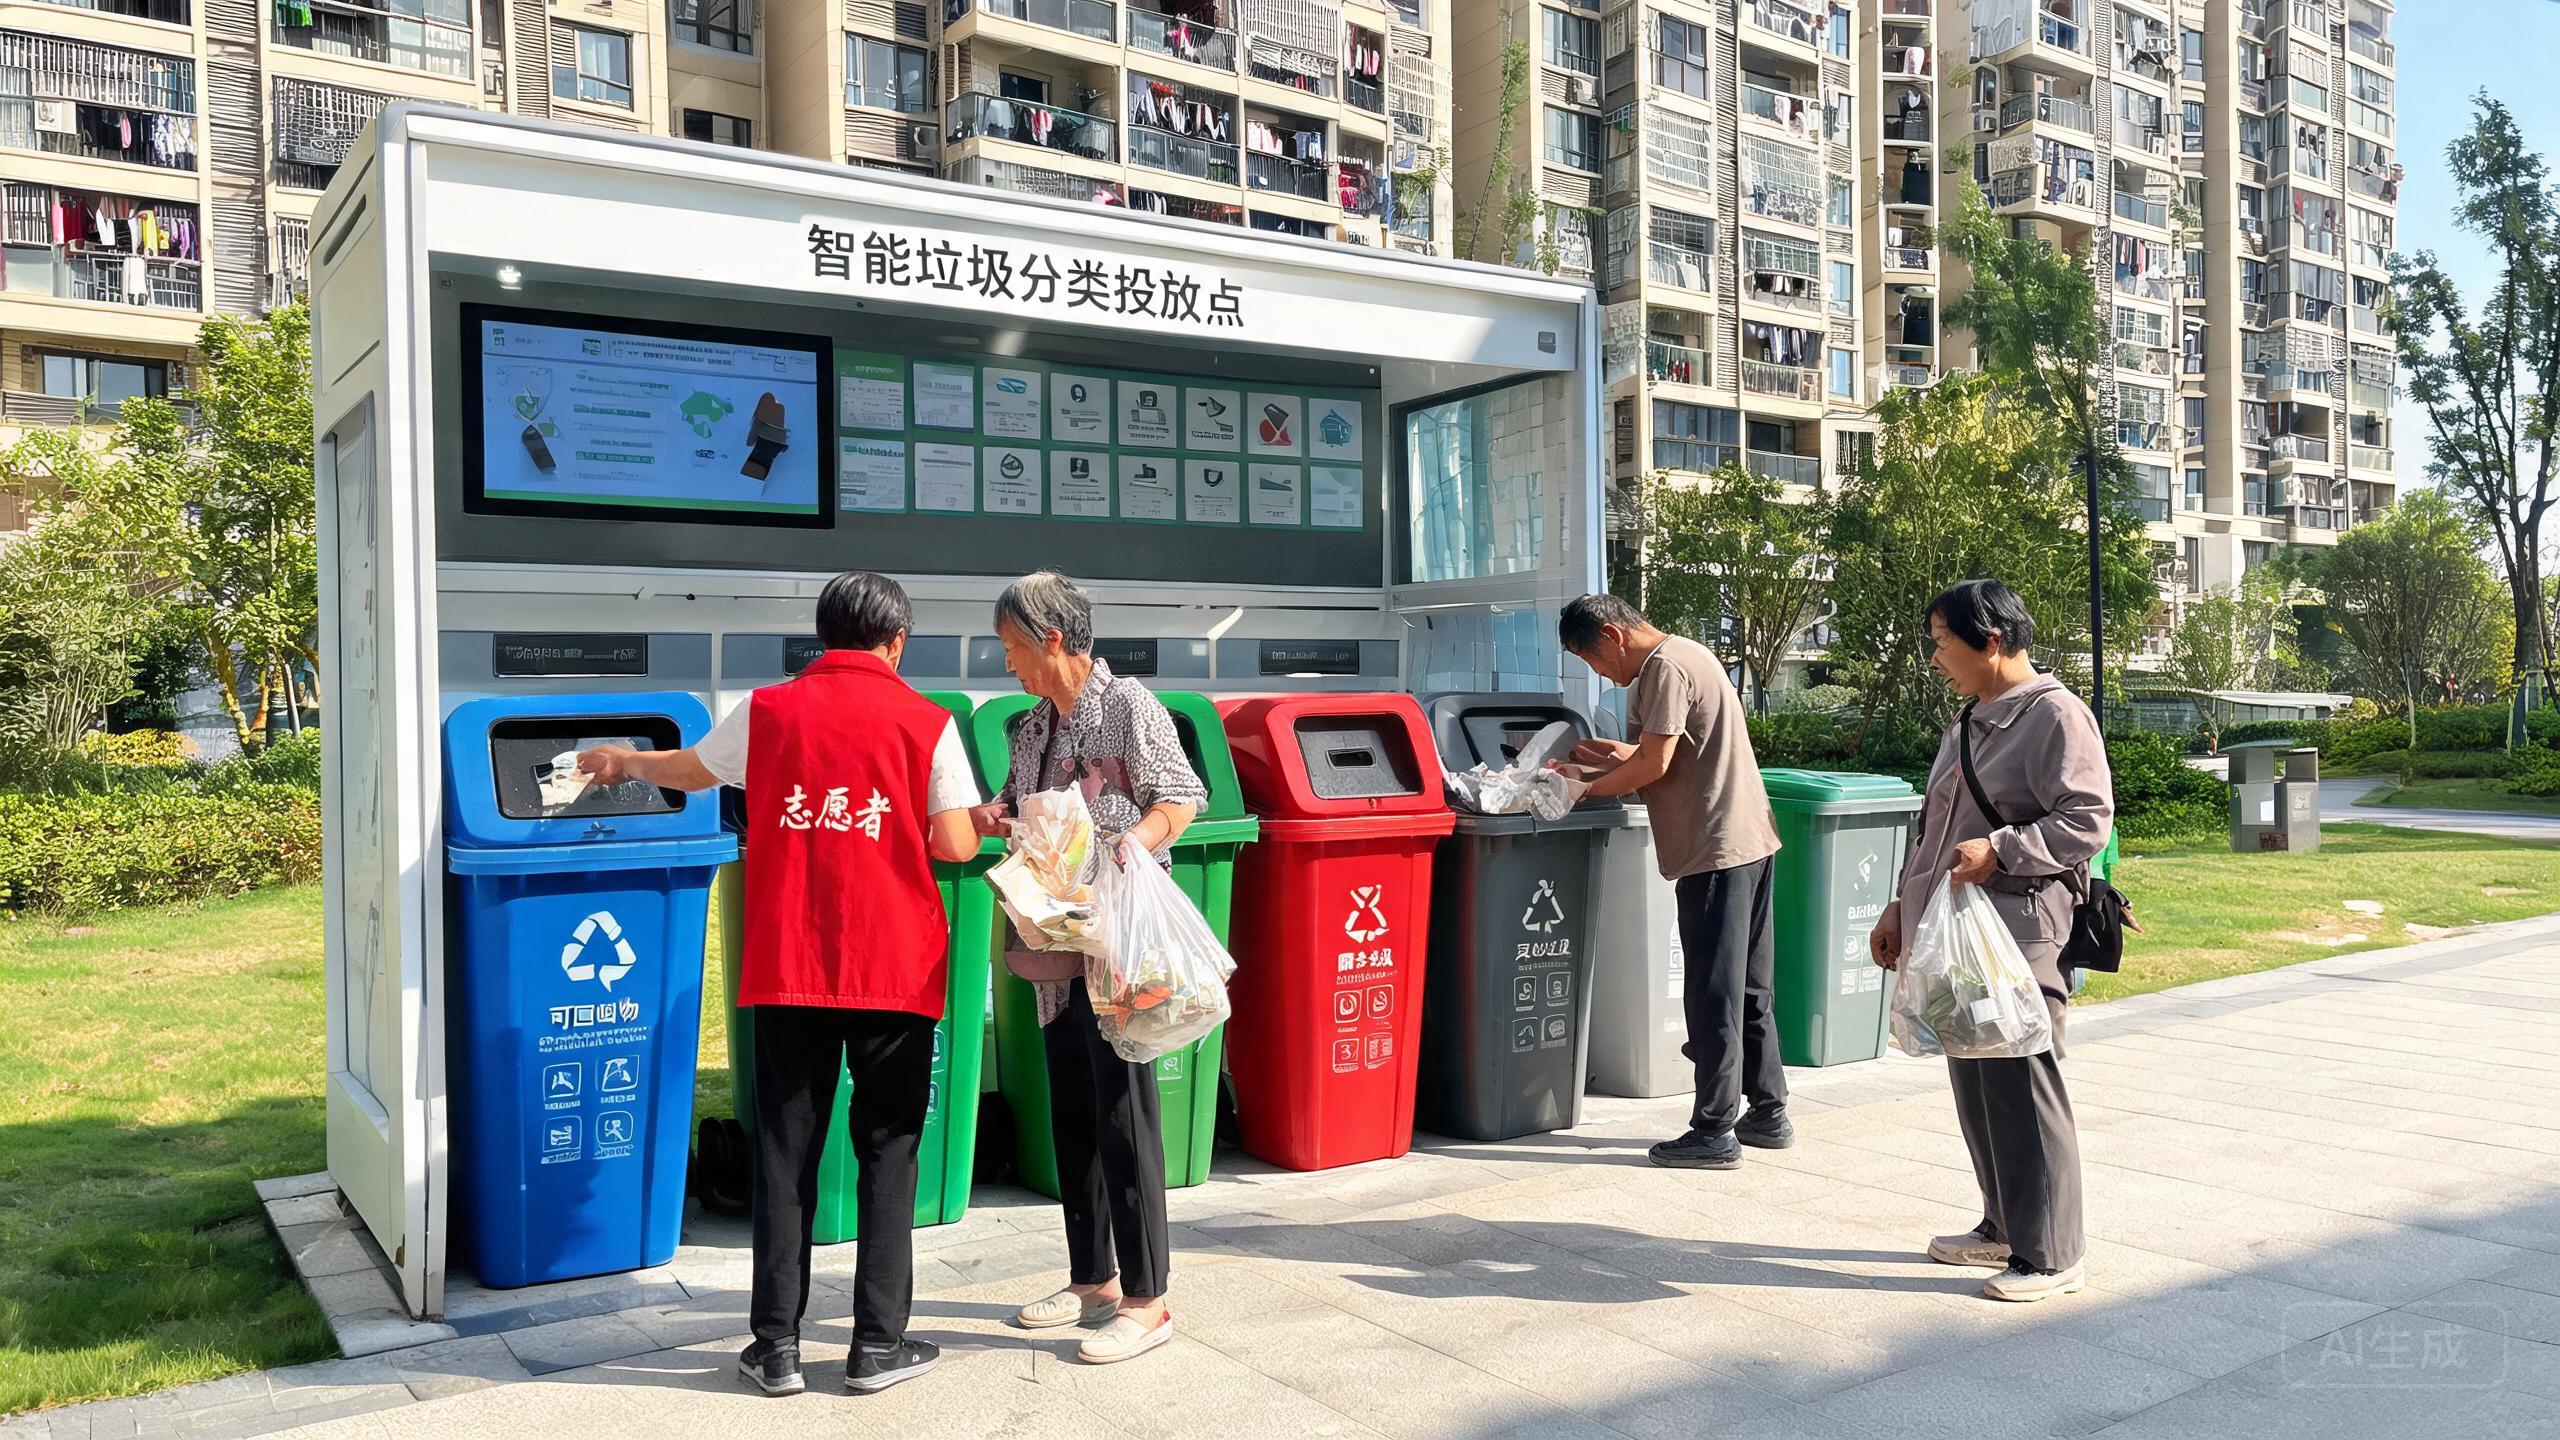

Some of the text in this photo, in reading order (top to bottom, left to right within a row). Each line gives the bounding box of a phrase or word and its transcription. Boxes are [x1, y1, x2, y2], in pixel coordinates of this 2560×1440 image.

[808, 223, 1244, 328] 智能垃圾分类投放点
[780, 784, 892, 842] 志愿者
